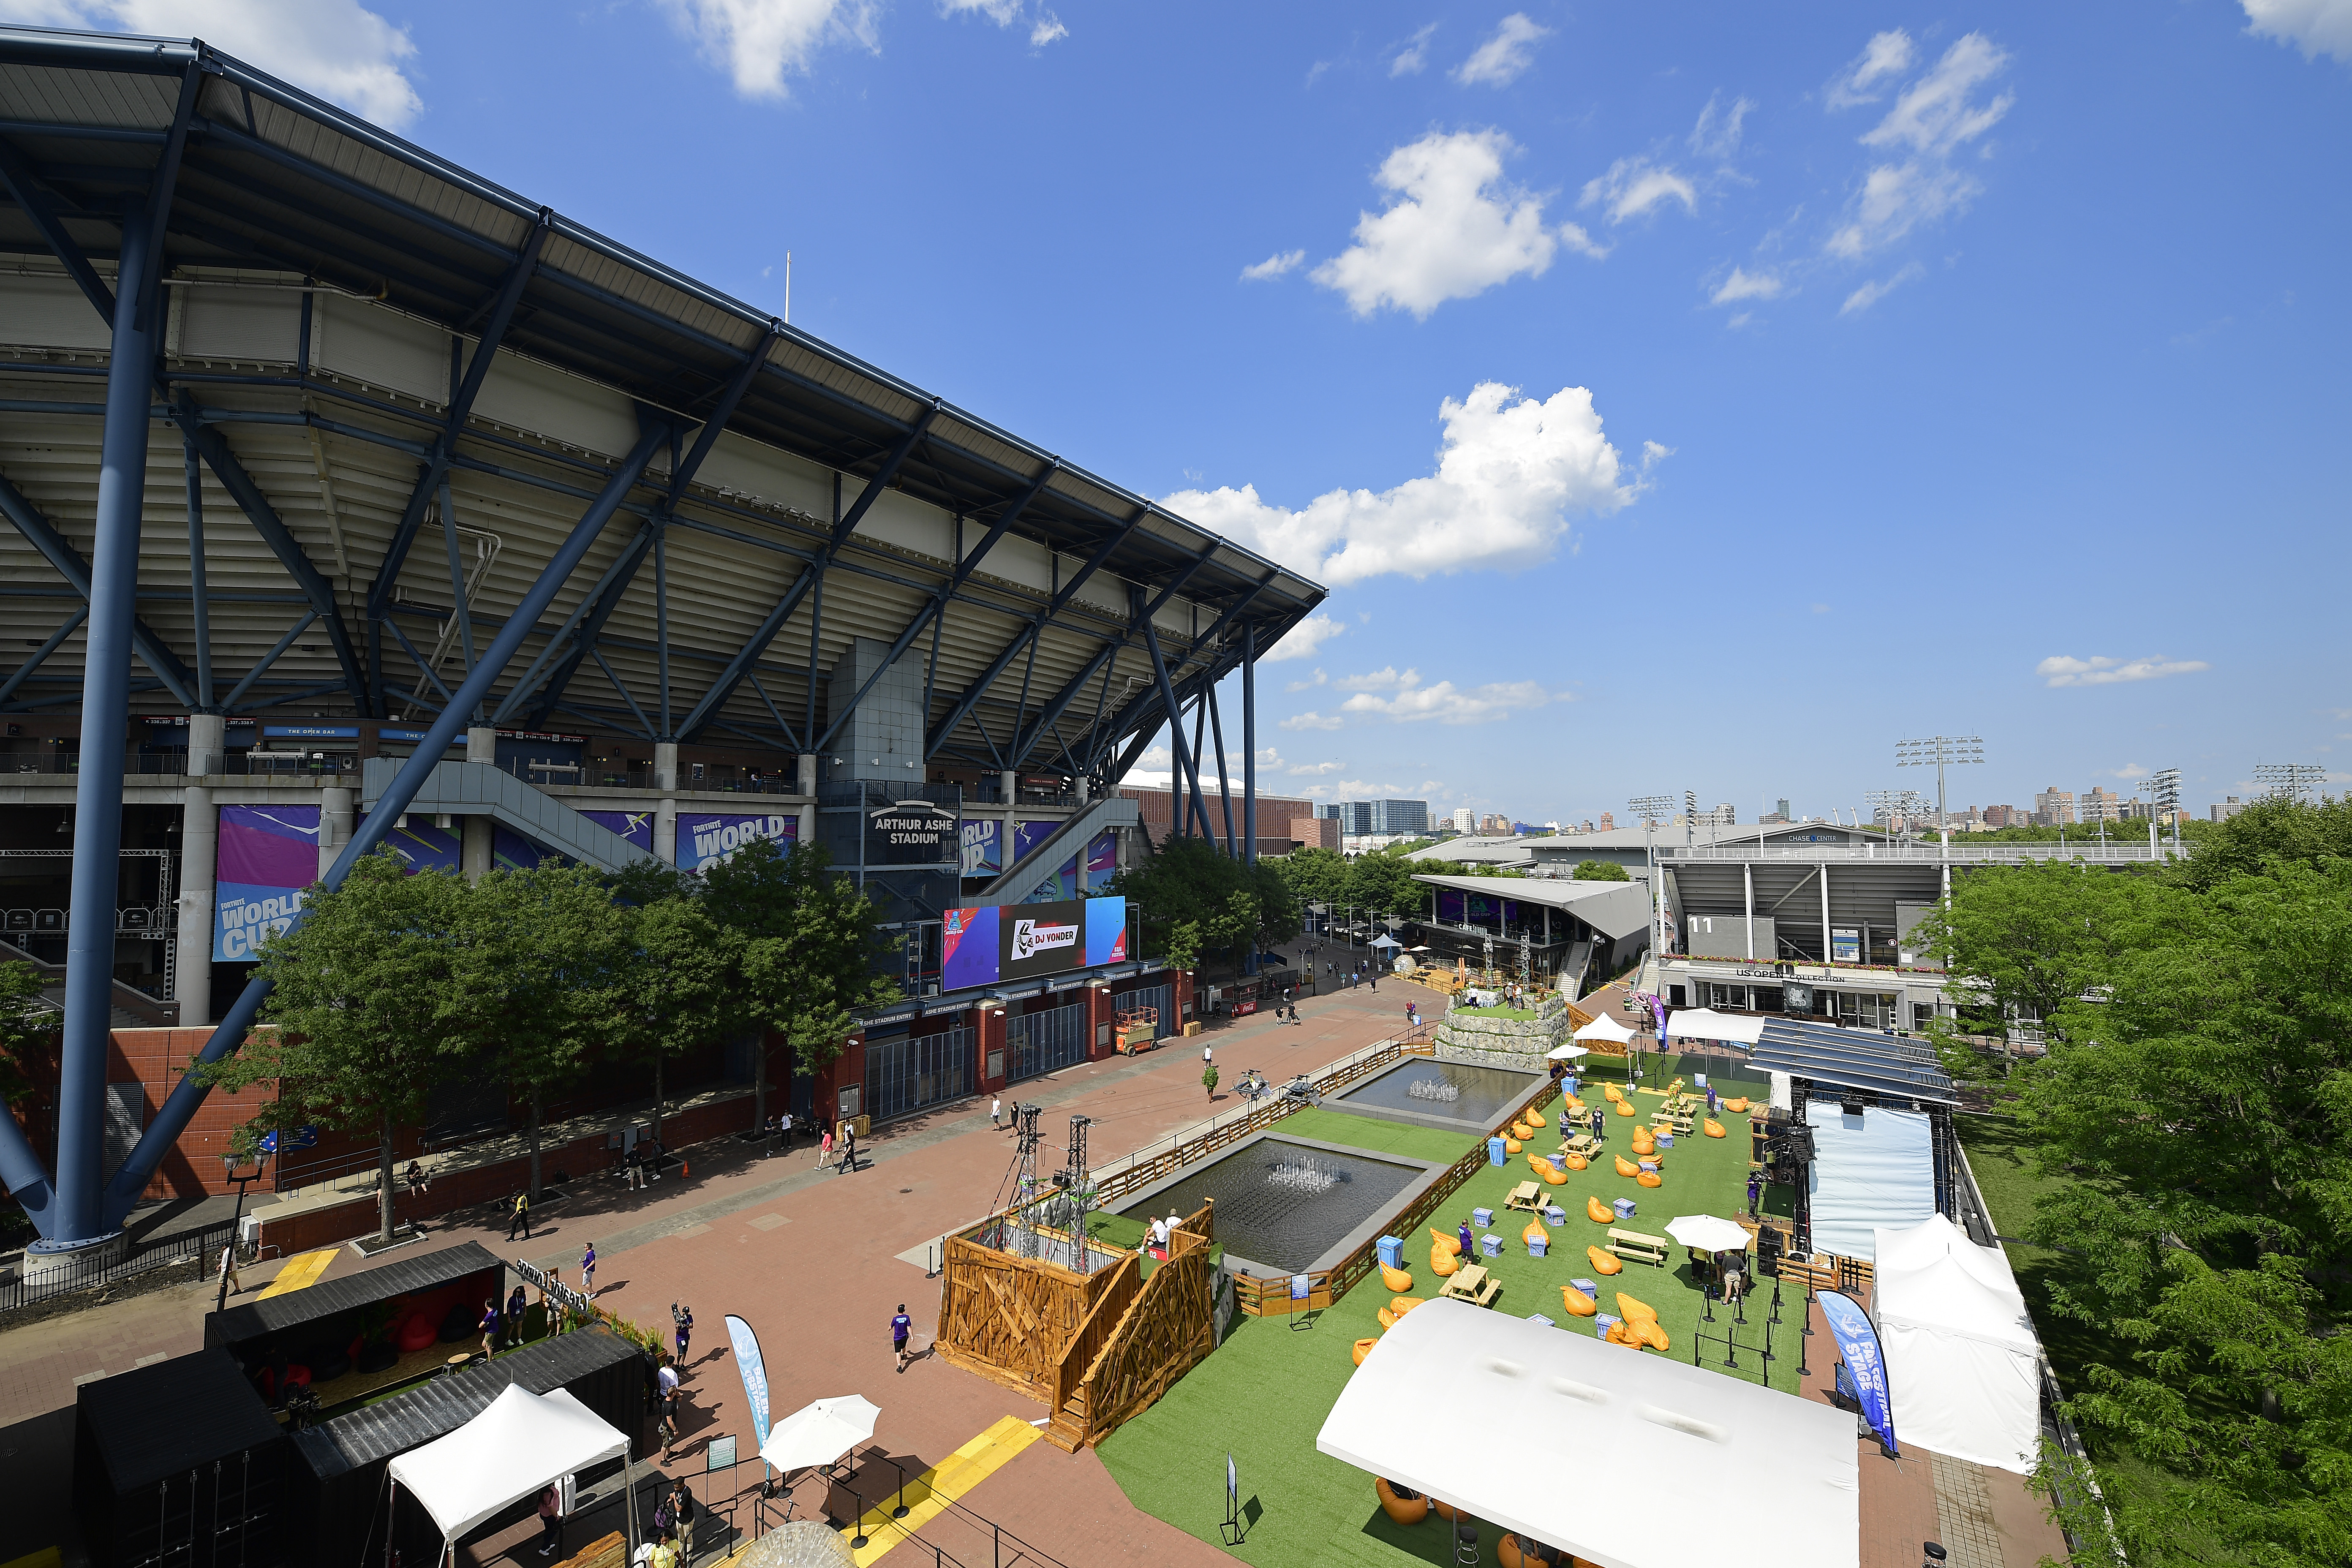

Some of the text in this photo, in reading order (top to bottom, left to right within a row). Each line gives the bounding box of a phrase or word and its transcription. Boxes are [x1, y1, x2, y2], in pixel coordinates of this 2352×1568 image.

[693, 819, 721, 834] FORTNITE
[875, 819, 953, 830] ARTHUR ASHE
[694, 815, 785, 858] WORLD
[890, 833, 938, 844] STADIUM
[961, 820, 994, 846] RLD
[220, 897, 245, 910] FORTNITE
[222, 891, 310, 929] WORLD
[1690, 917, 1712, 933] 11
[1035, 931, 1073, 944] DJ YONDER
[1790, 974, 1845, 983] COLLECTION
[874, 1015, 896, 1024] STADIUM
[1149, 1250, 1157, 1259] 02
[1846, 1343, 1873, 1391] STAGE
[752, 1367, 769, 1415] BALLER
[1859, 1342, 1891, 1429] FAN FESTIVAL
[744, 1370, 763, 1421] OBSTACLE
